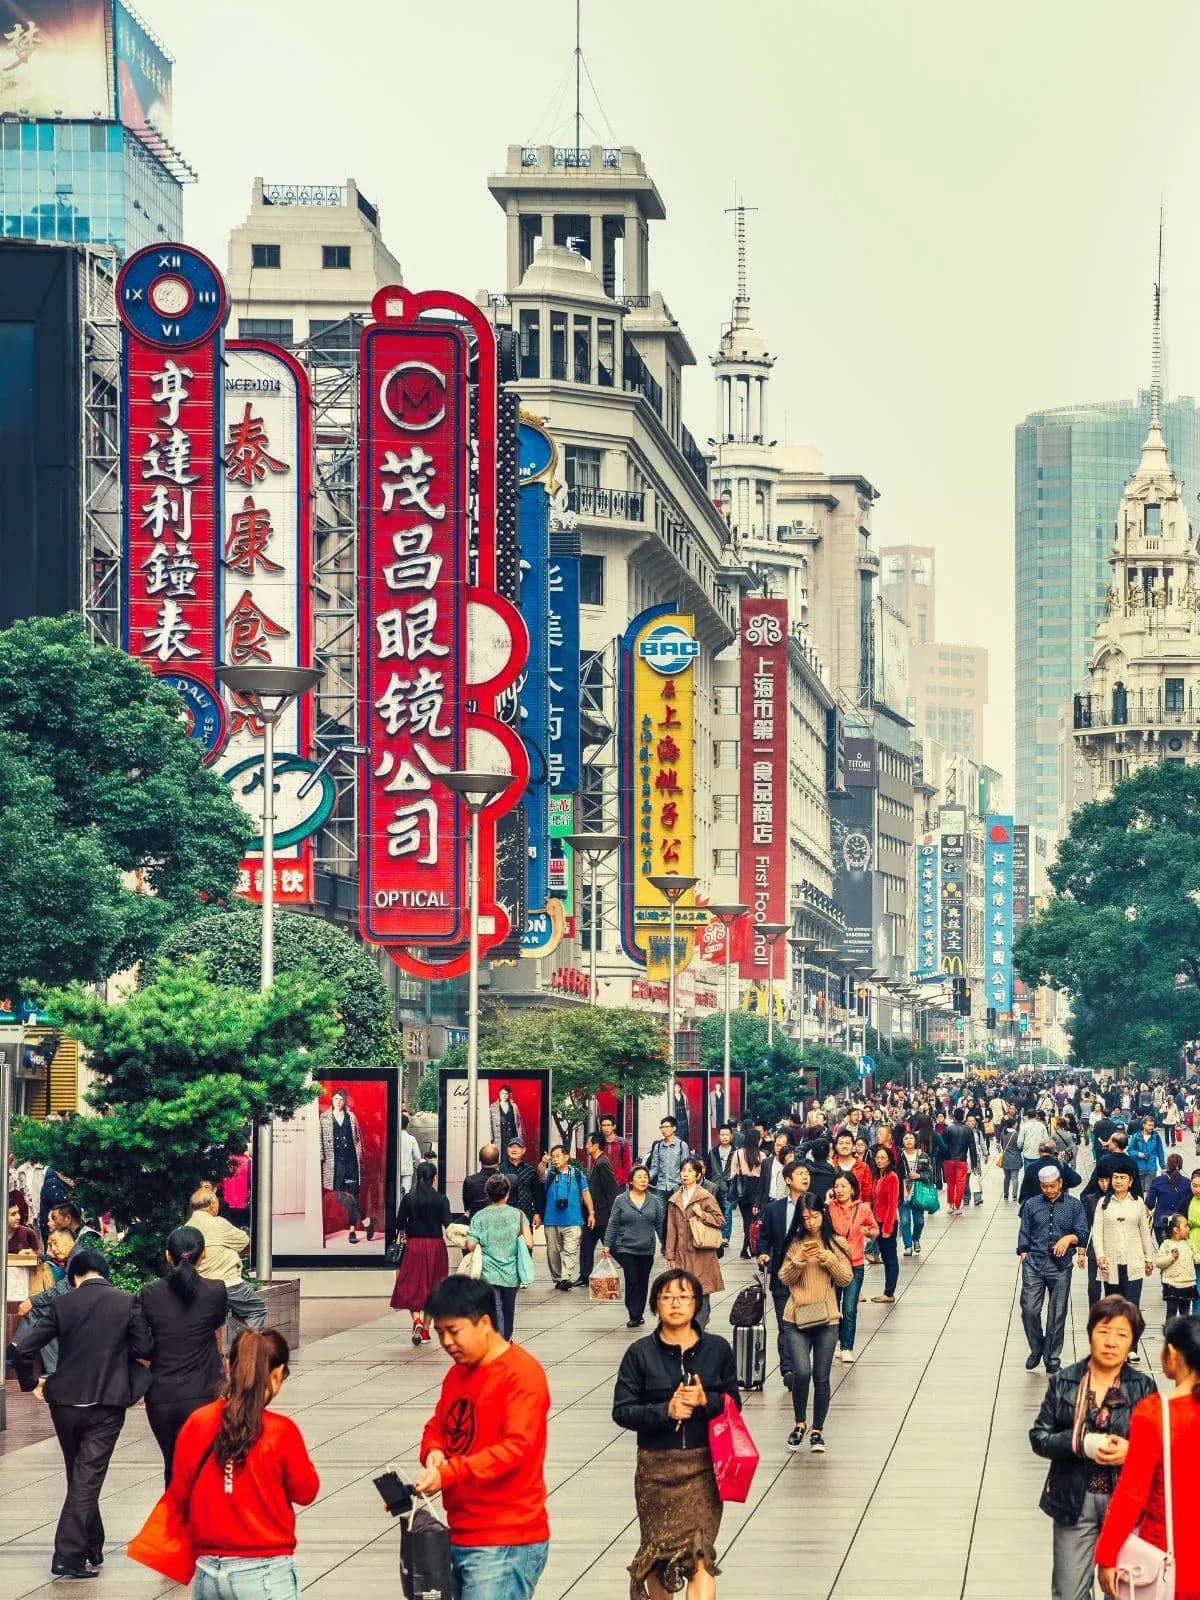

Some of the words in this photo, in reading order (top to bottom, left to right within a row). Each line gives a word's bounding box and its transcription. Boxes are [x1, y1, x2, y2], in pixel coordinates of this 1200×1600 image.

[375, 446, 452, 865] 茂昌眼镜公司
[640, 642, 698, 656] BAC
[752, 656, 774, 844] 上海市第一食品商店
[847, 759, 871, 769] TITONI
[755, 856, 769, 888] First
[375, 890, 449, 908] OPTICAL
